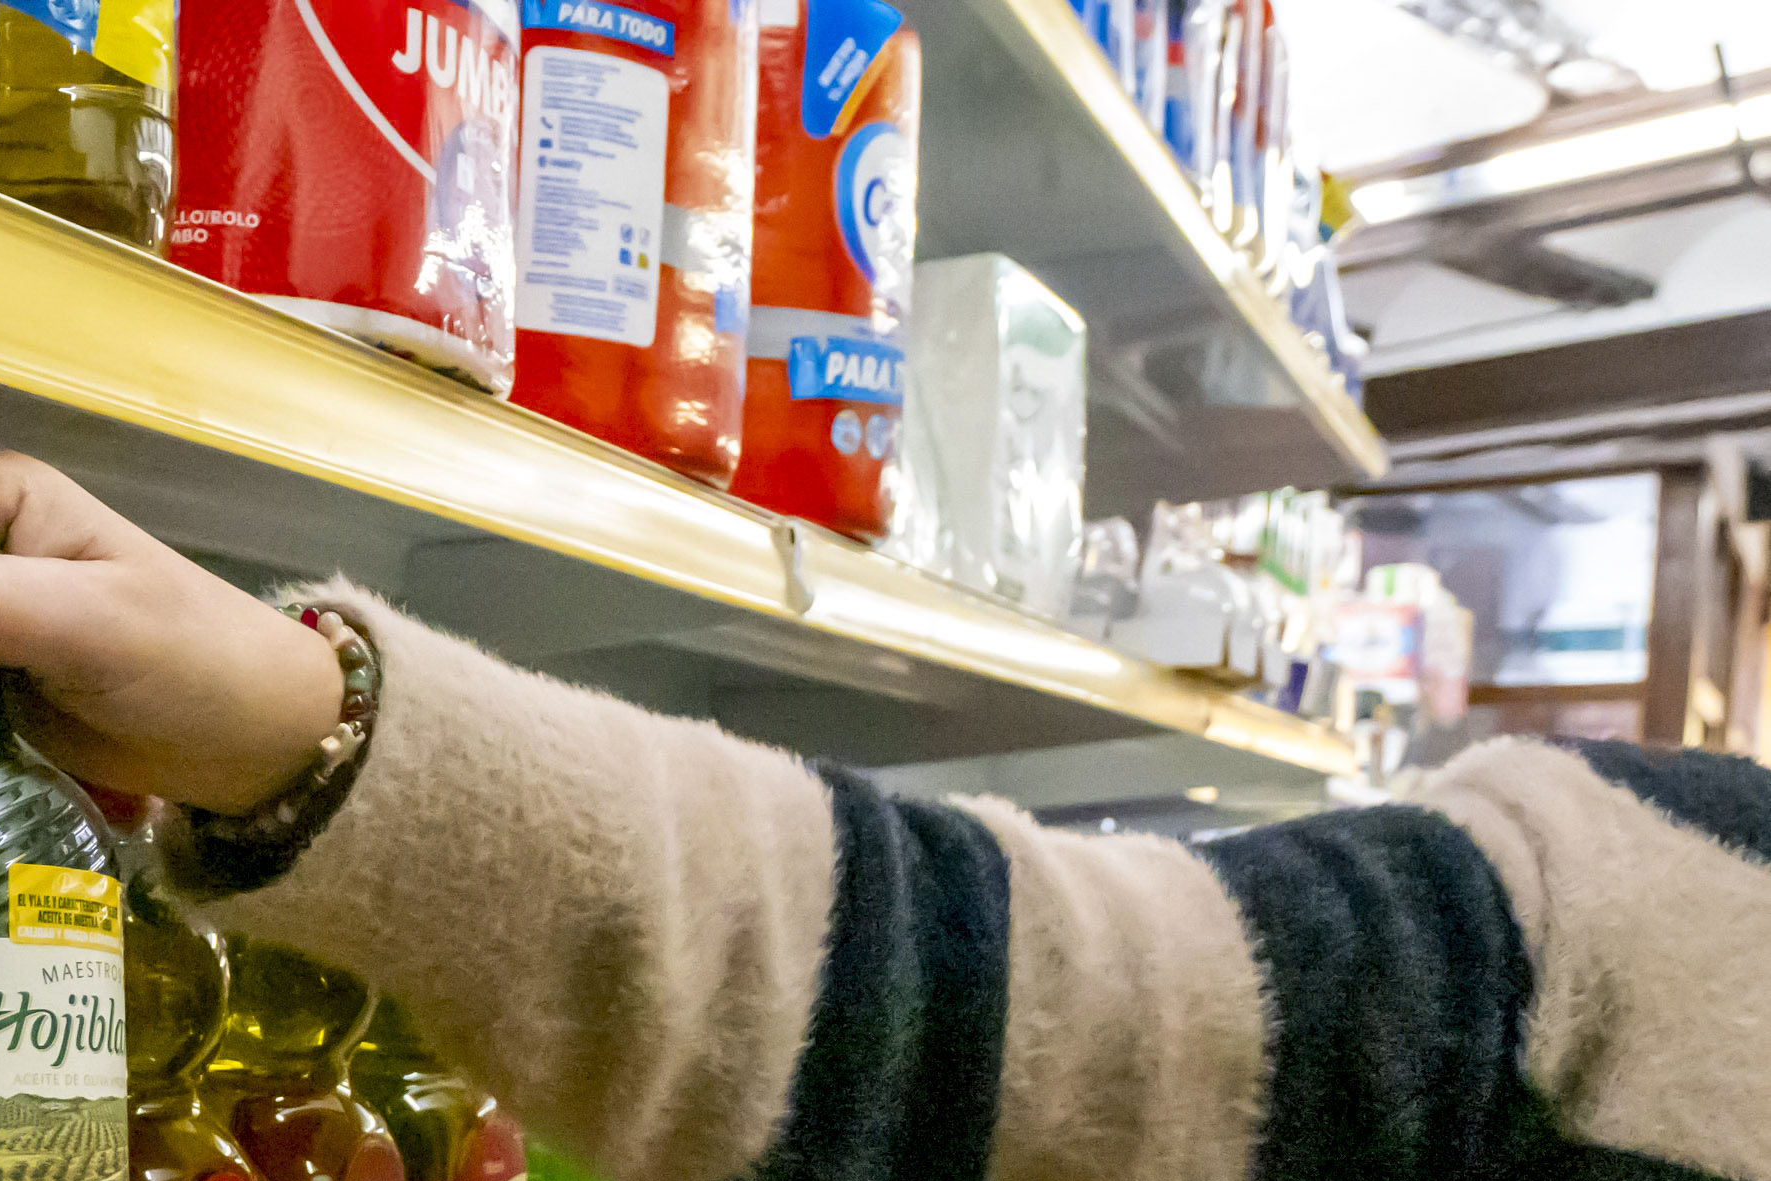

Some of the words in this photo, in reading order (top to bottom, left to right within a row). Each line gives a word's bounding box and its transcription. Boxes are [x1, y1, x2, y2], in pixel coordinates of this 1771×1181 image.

[558, 4, 613, 30] PARA
[619, 13, 667, 46] TODO
[173, 209, 260, 228] LO/ROLO
[825, 351, 892, 391] PARA
[17, 893, 26, 907] EL
[28, 894, 50, 909] VIAJE
[51, 896, 57, 908] Y
[38, 910, 62, 924] ACEITE
[64, 912, 72, 925] DE
[13, 1073, 59, 1086] ACEITE
[65, 1074, 78, 1086] DE
